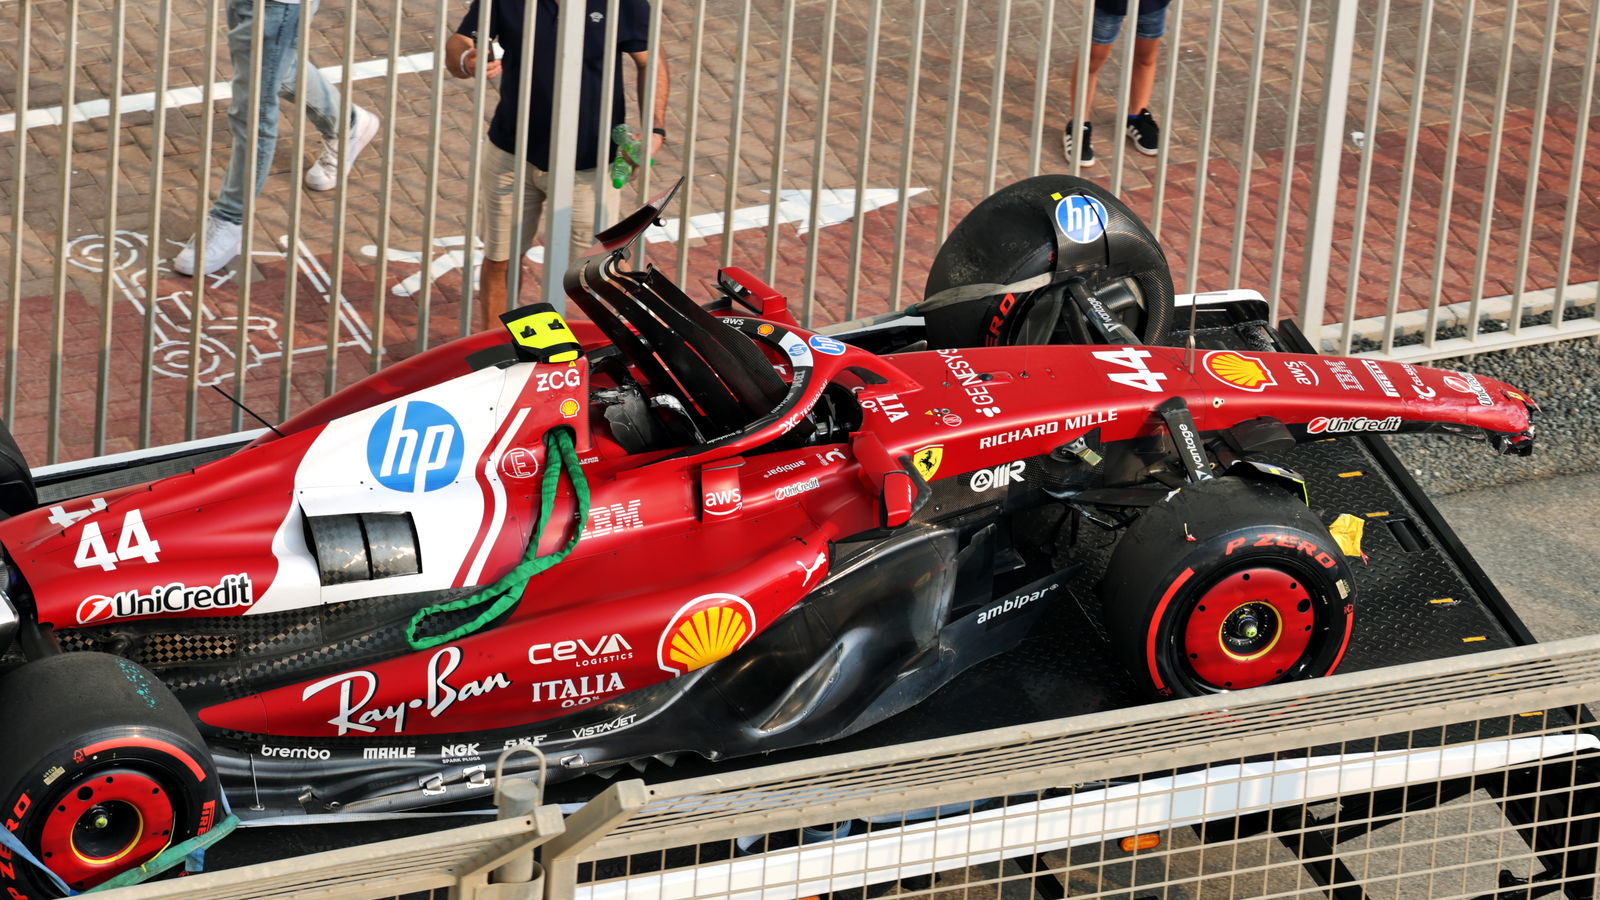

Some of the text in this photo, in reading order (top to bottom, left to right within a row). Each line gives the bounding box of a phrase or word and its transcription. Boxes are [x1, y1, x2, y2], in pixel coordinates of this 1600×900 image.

[1066, 196, 1102, 242] hp
[722, 317, 745, 326] aws
[535, 368, 581, 392] ZCG
[1091, 347, 1168, 392] 44
[1283, 360, 1313, 386] aws
[1360, 359, 1401, 397] PIRELLI
[876, 393, 910, 424] LIA
[979, 420, 1059, 451] RICHARD
[1064, 407, 1119, 431] MILLE
[1329, 417, 1400, 433] UniCredit
[380, 403, 455, 493] hp
[705, 488, 742, 507] aws
[784, 480, 818, 497] UniCredit
[73, 508, 162, 572] 44
[1225, 533, 1338, 569] P ZERO
[115, 576, 250, 617] UniCredit
[575, 652, 634, 668] LOGISTICS
[531, 672, 626, 703] ITALIA
[261, 744, 331, 761] brembo
[362, 747, 416, 760] MAHLE
[441, 743, 480, 758] NGK
[502, 734, 548, 751] SKF
